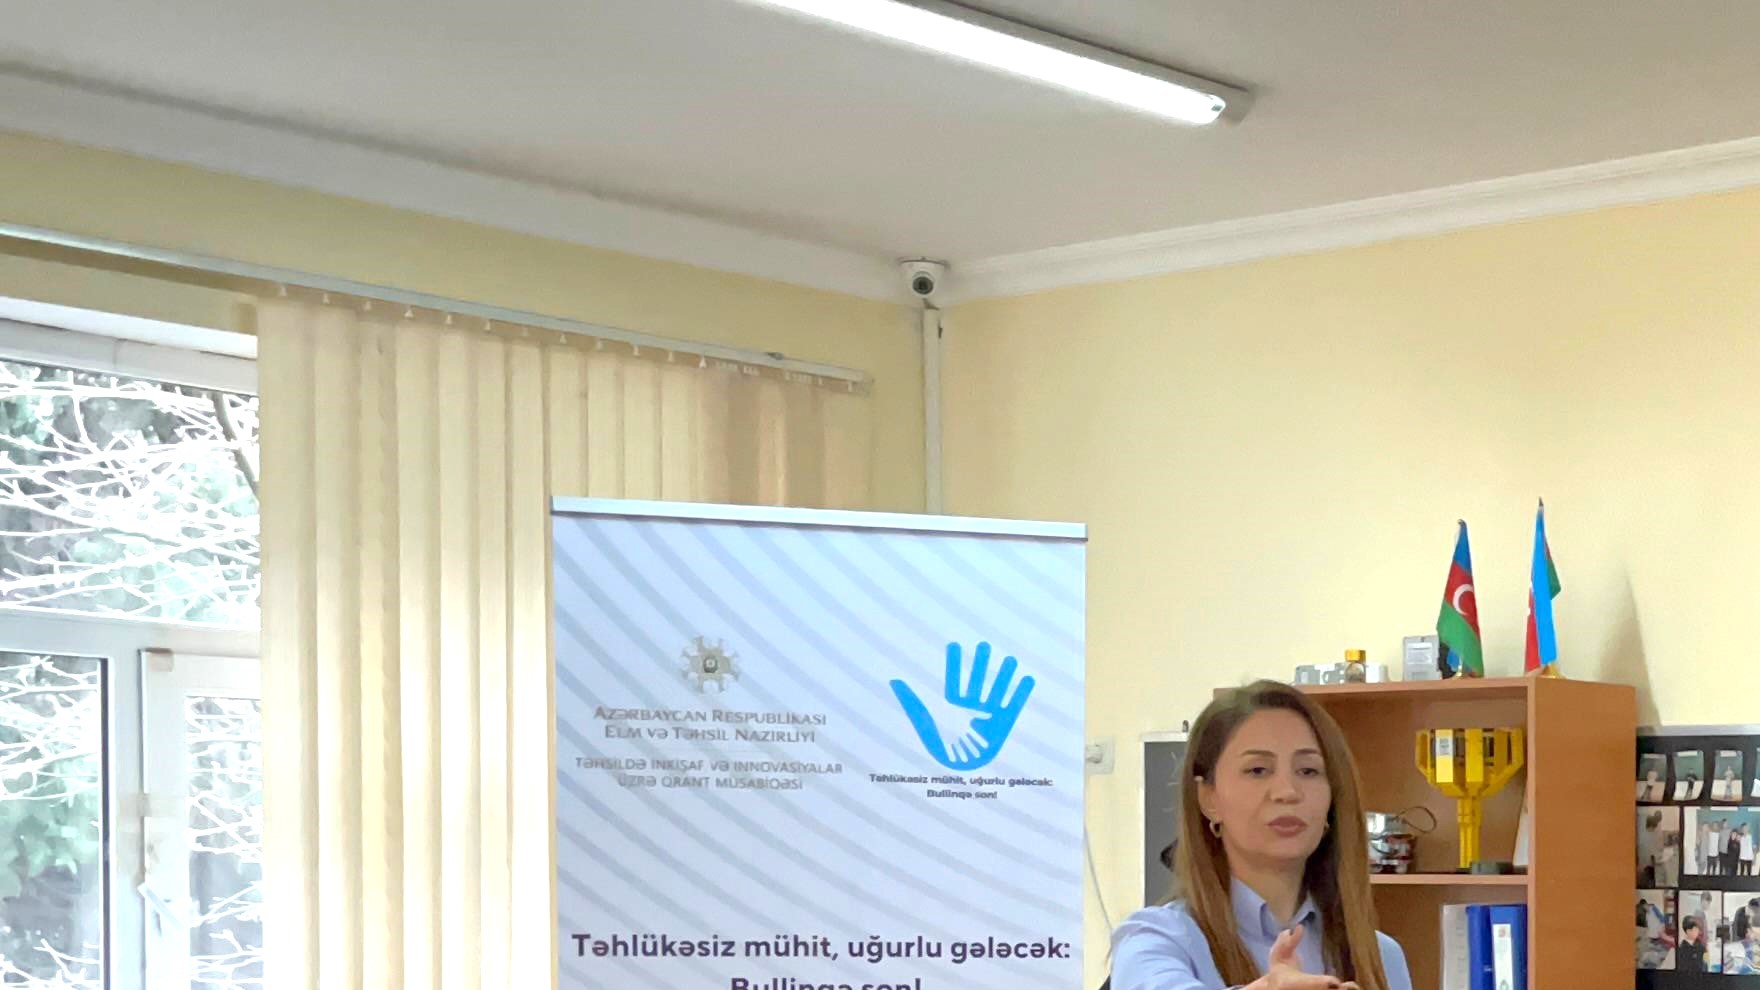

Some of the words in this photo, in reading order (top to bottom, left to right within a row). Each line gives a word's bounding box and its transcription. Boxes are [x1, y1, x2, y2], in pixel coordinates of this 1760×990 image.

[572, 933, 736, 958] Təhlükəsiz
[744, 934, 838, 961] mühit,
[848, 935, 942, 963] uğurlu
[951, 937, 1071, 963] gələcək:
